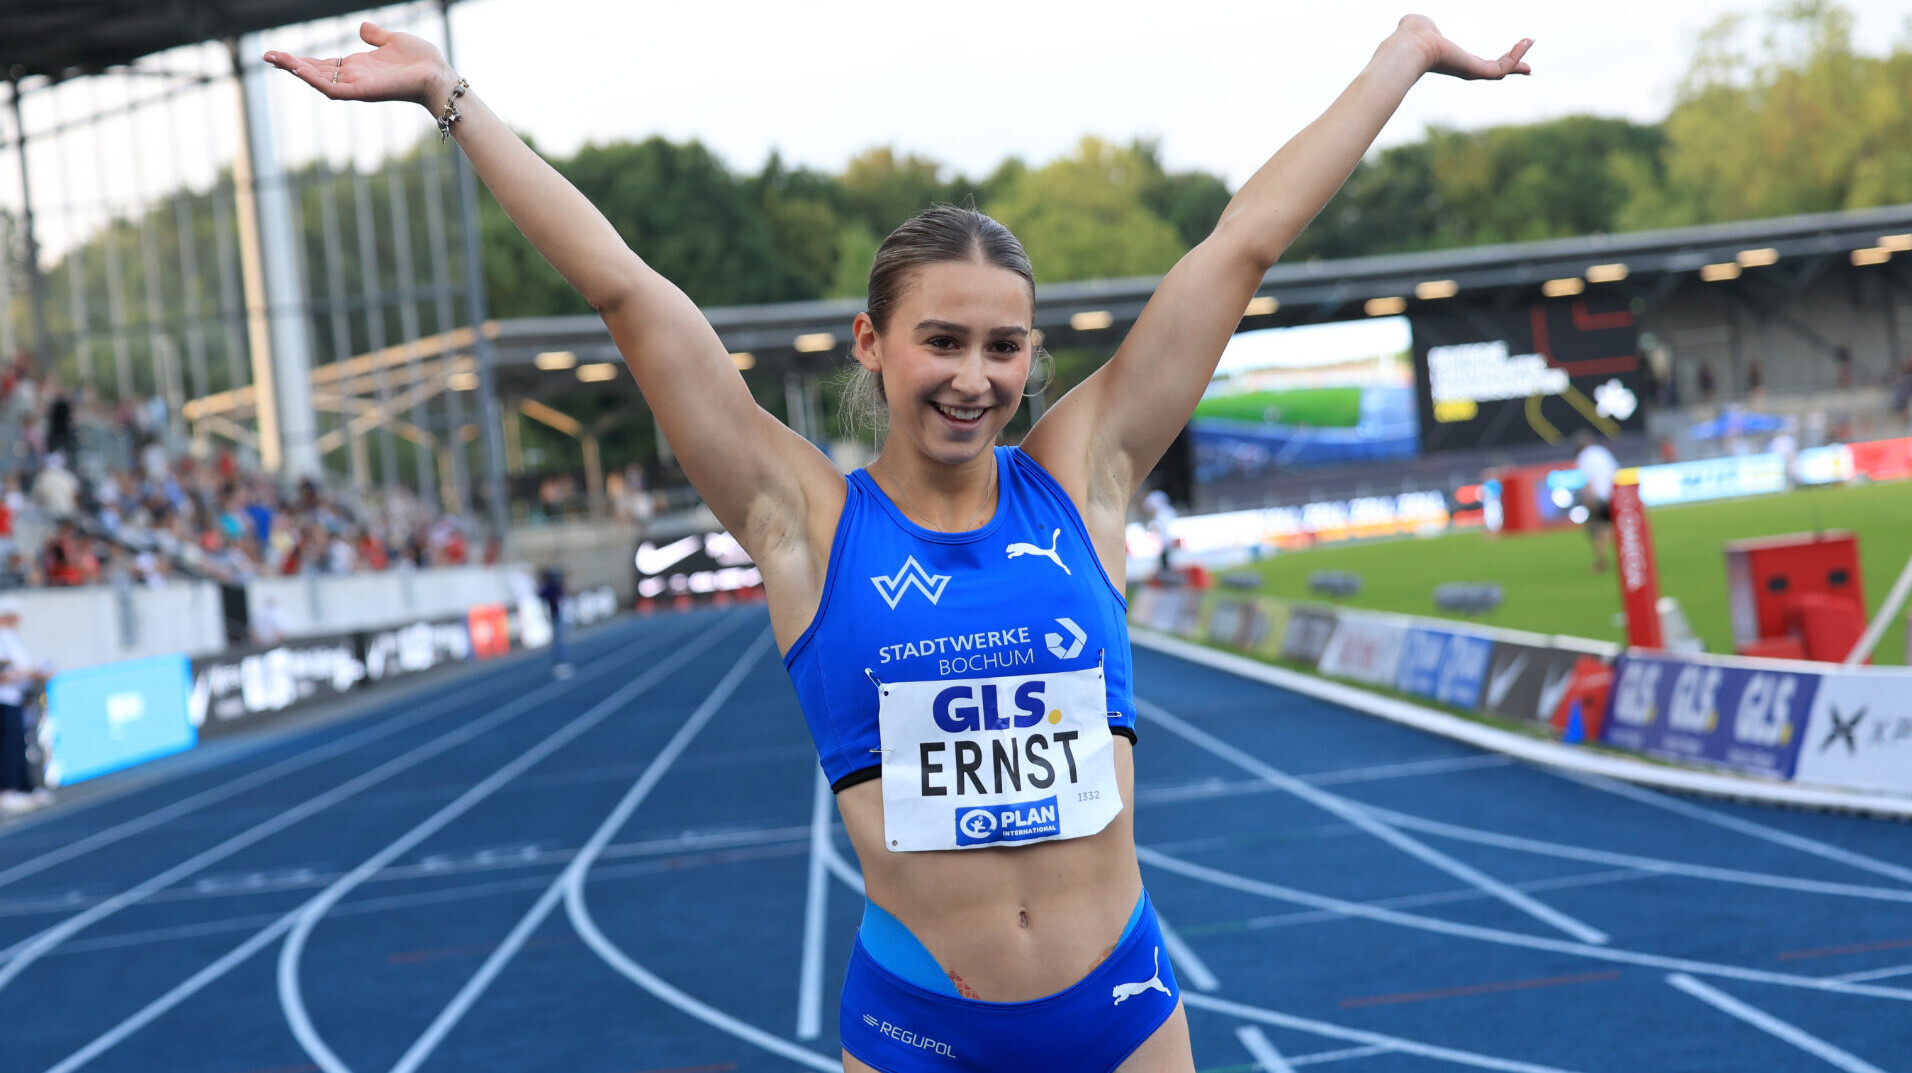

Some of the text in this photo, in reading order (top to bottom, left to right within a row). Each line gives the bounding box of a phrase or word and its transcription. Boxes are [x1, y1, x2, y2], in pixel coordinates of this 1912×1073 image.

[879, 627, 1031, 664] STADTWERKE
[939, 648, 1034, 676] BOCHUM
[919, 730, 1079, 797] ERNST
[1077, 790, 1101, 802] 1332
[1001, 805, 1056, 828] PLAN
[1002, 824, 1057, 837] INTERNATIONAL
[879, 1021, 957, 1059] REGUPOL
